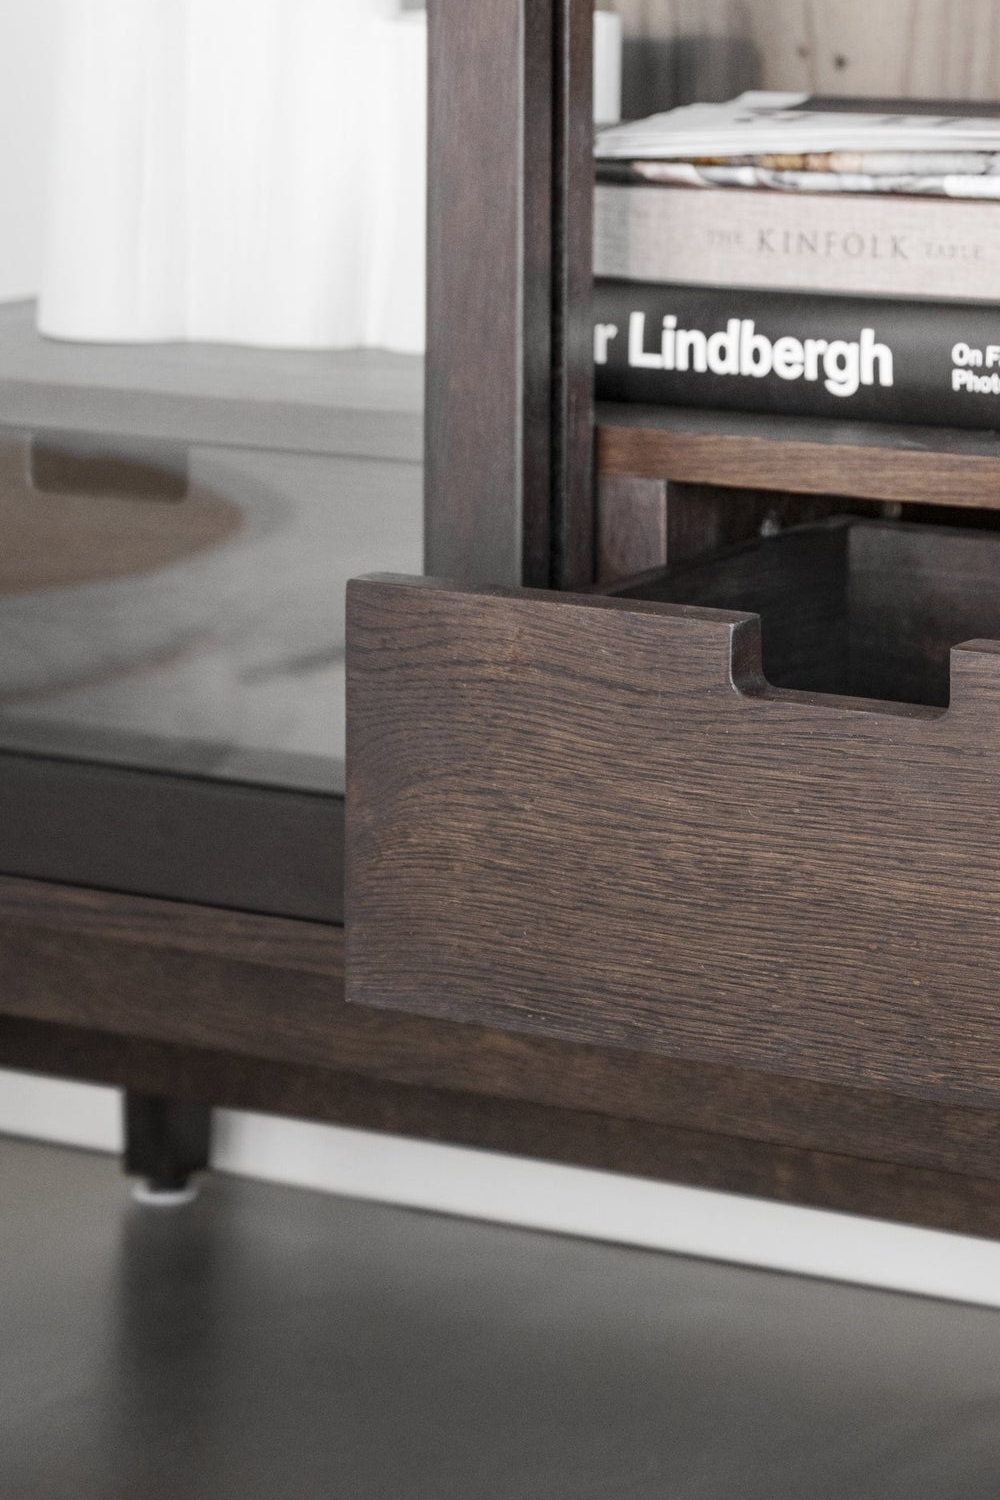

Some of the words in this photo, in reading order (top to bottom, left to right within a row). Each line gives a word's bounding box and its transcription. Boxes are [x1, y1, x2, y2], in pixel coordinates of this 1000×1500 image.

[757, 228, 909, 260] KINFOLK
[628, 311, 894, 397] Lindbergh
[951, 342, 983, 367] On
